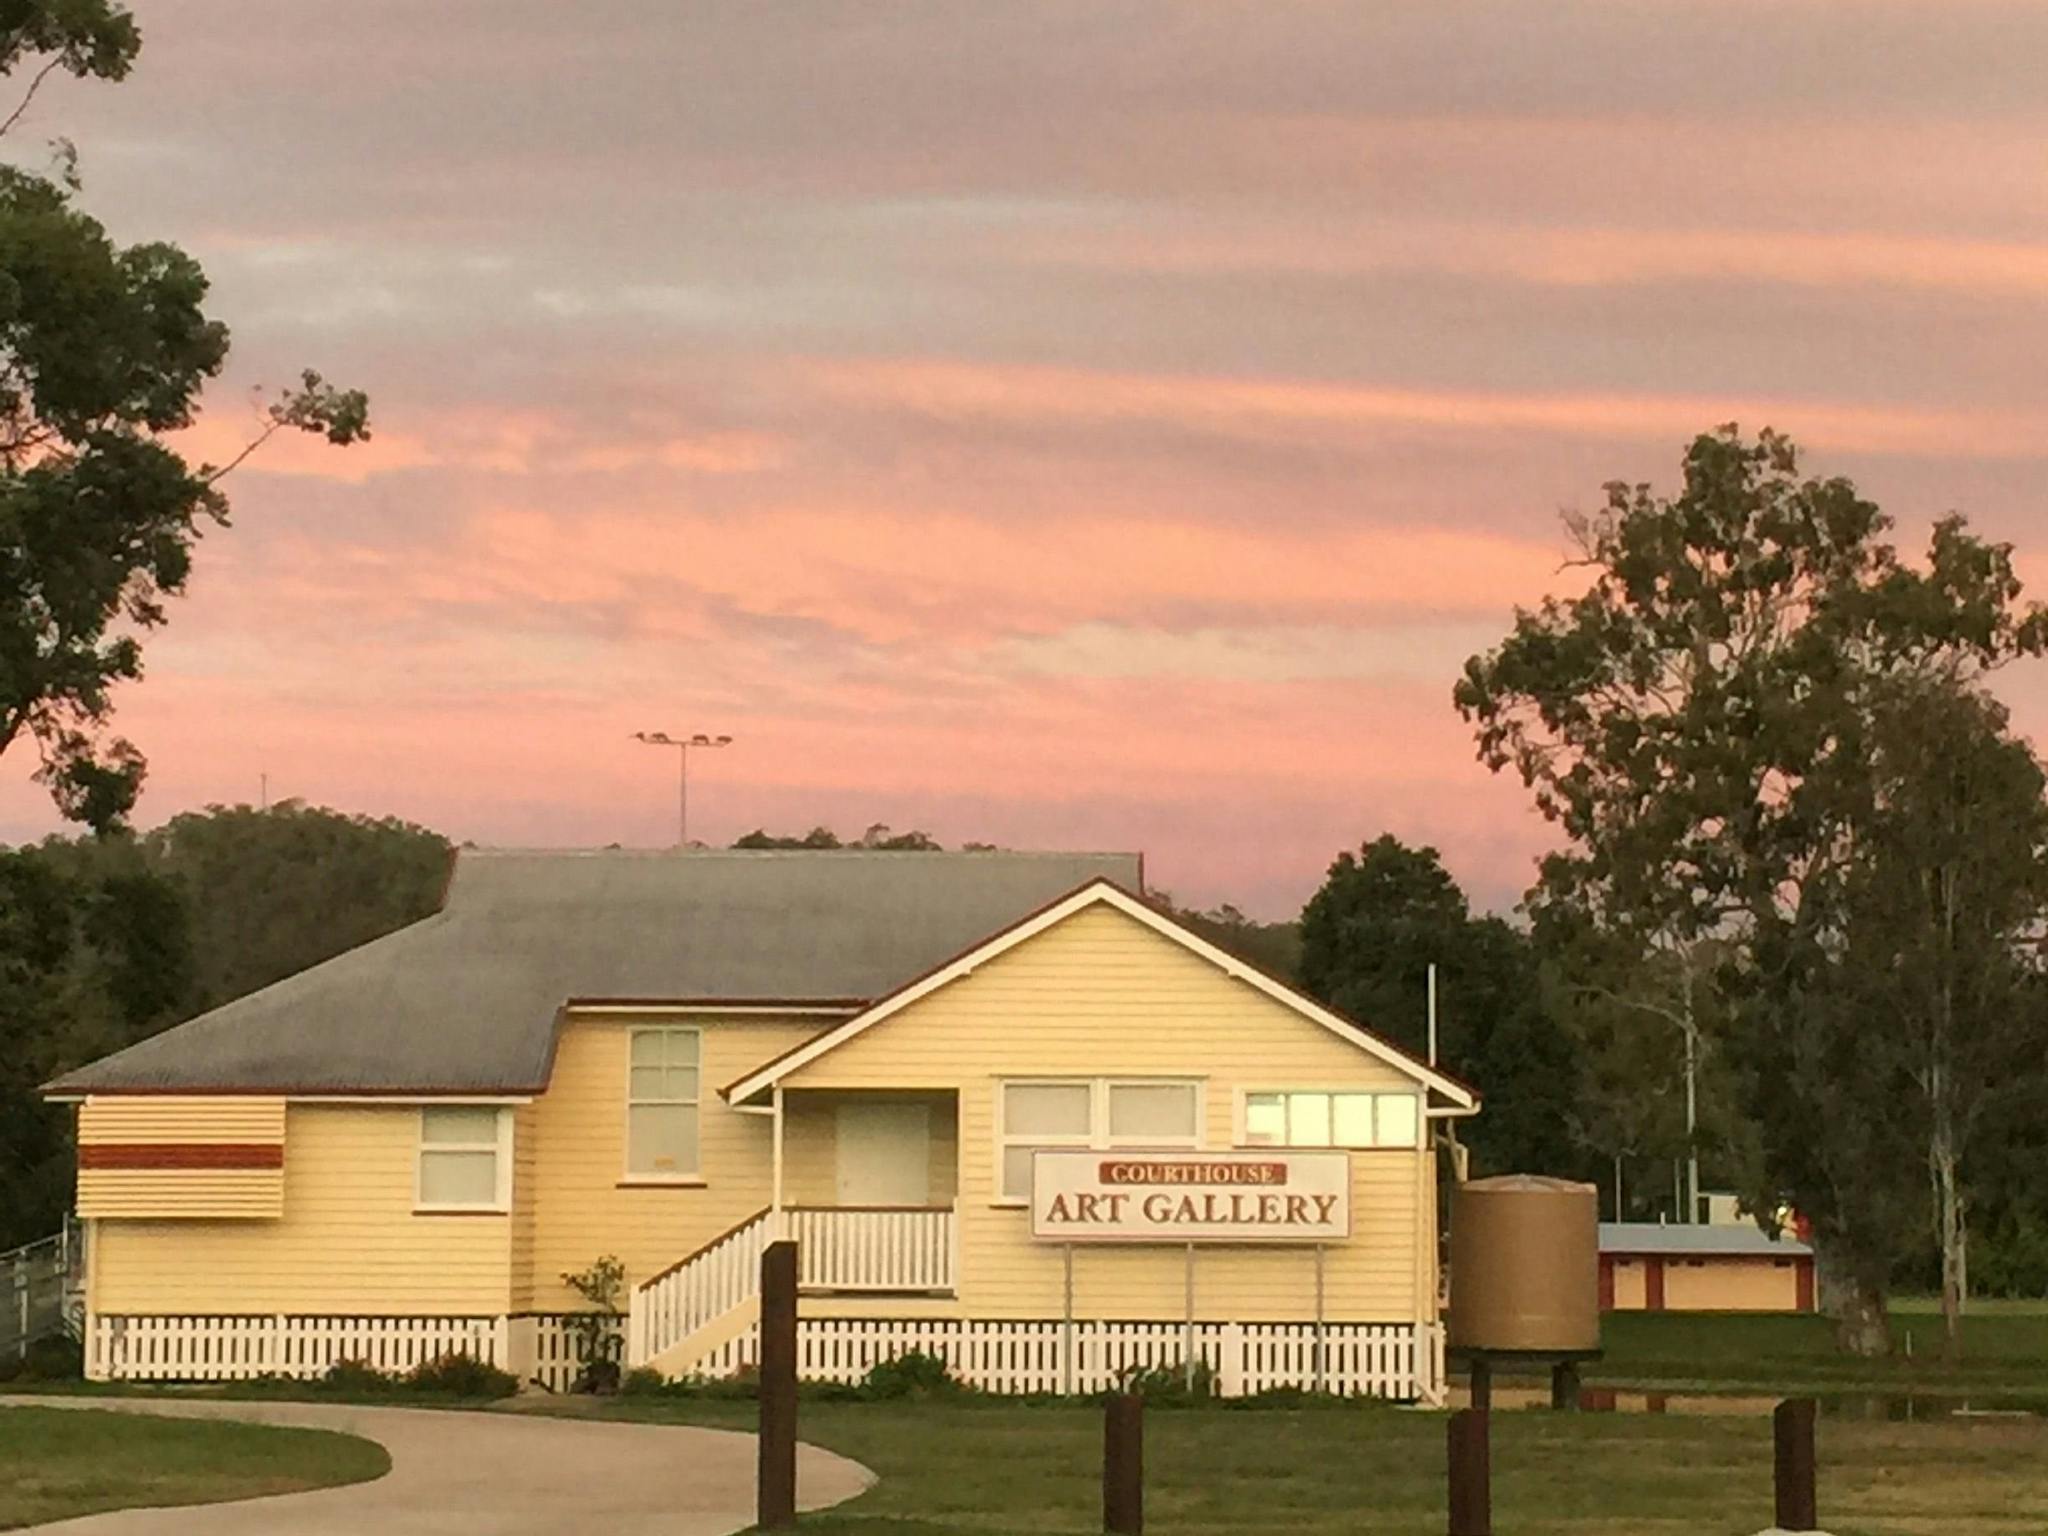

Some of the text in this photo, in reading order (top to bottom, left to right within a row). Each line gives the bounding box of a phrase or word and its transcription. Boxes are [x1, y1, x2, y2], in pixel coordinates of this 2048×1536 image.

[1111, 1164, 1275, 1183] COURTHOUSE
[1046, 1193, 1338, 1224] ART GALLERY
